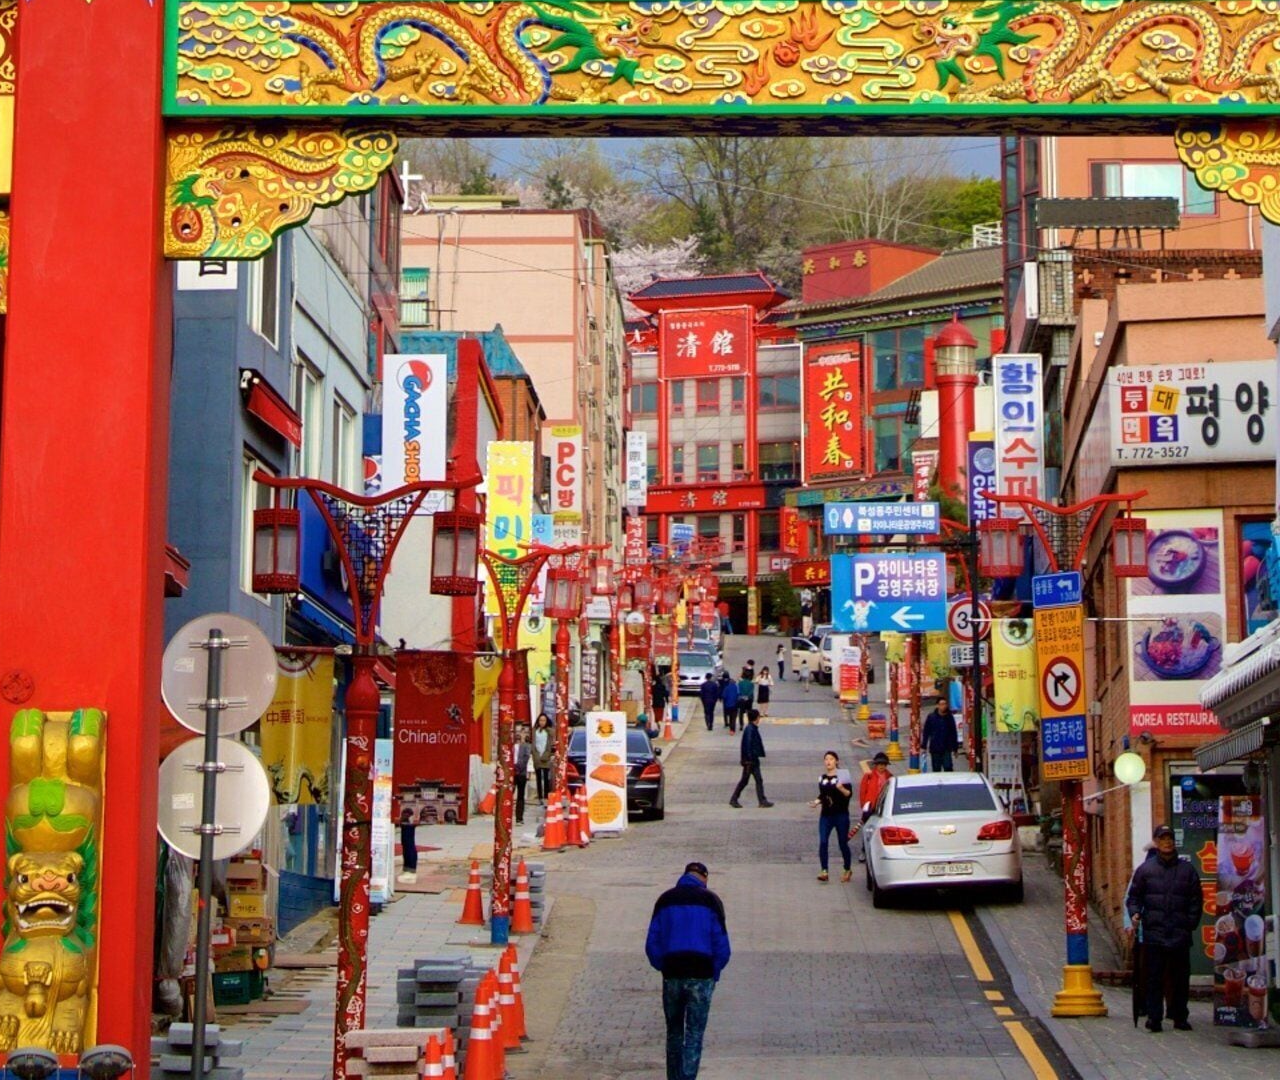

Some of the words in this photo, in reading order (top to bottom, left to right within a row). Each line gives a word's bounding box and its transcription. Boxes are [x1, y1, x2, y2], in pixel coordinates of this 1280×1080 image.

[403, 375, 422, 441] GACHA
[820, 368, 851, 465] 共和春
[1186, 381, 1269, 447] 평양
[1117, 449, 1128, 460] T.
[1132, 445, 1189, 460] 772-3527
[556, 442, 575, 508] PC방
[855, 562, 875, 597] P
[877, 560, 937, 578] 차이나타운
[877, 579, 938, 597] 공영주차장
[266, 708, 305, 726] 中華街
[1132, 713, 1163, 726] KOREA
[399, 729, 467, 744] Chinatown
[1044, 720, 1083, 744] 공영주차장
